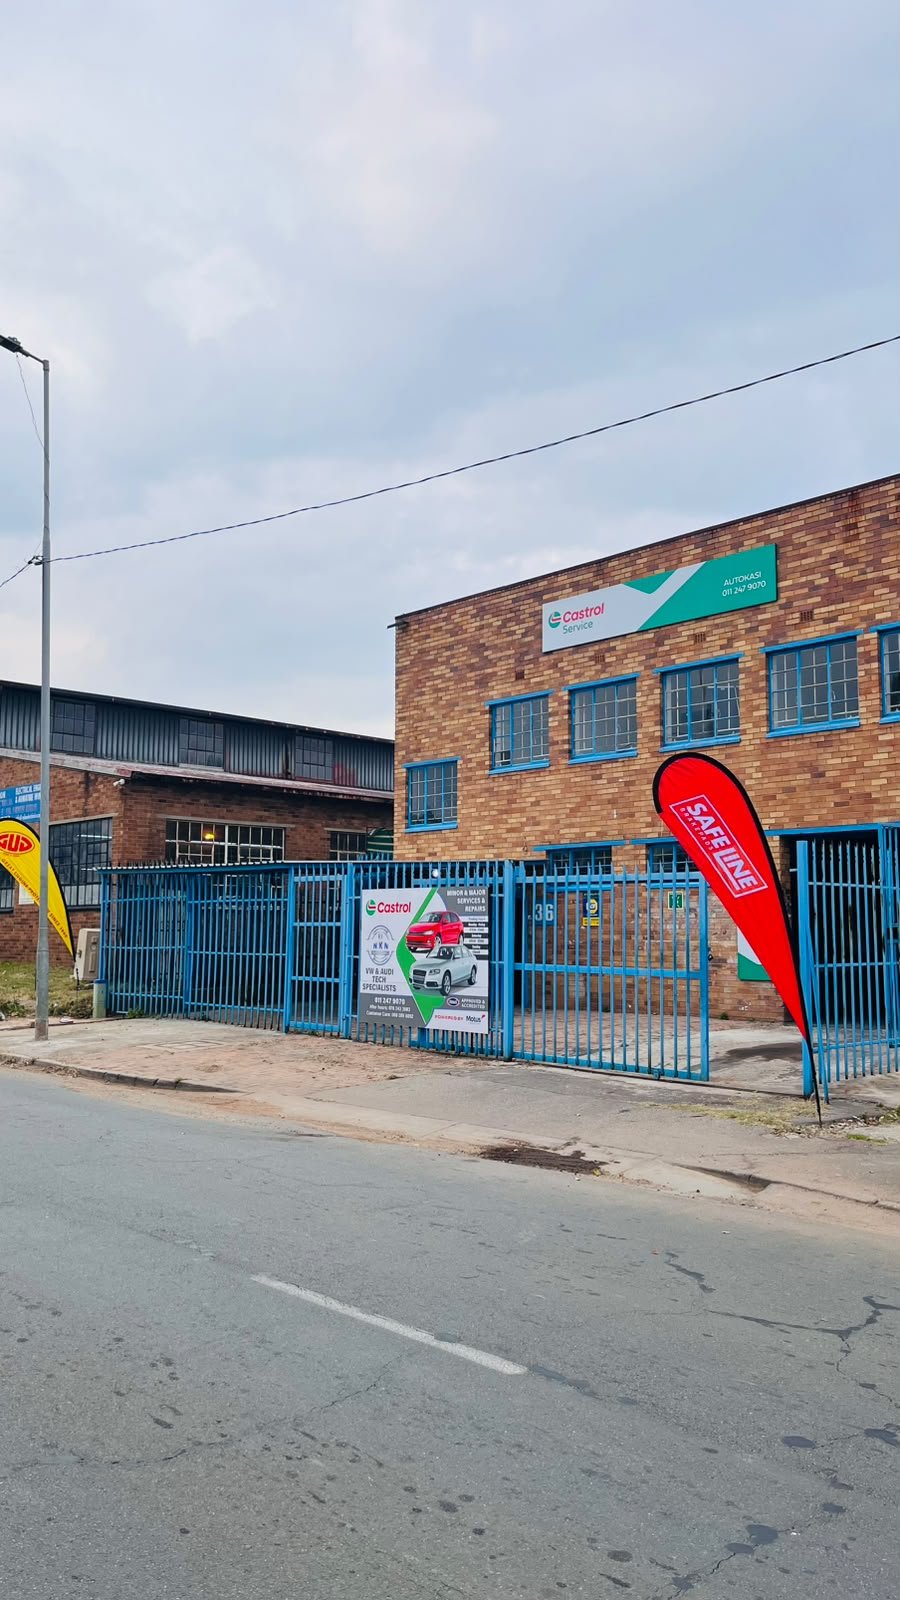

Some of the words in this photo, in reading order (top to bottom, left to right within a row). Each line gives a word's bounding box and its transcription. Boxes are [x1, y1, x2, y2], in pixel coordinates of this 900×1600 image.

[723, 571, 762, 587] AUTOKASI
[722, 588, 733, 597] 011
[734, 585, 746, 595] 247
[747, 580, 767, 591] 9070
[562, 602, 605, 623] Castrol
[562, 620, 593, 634] Service
[0, 833, 33, 852] GUD
[377, 901, 411, 913] Castrol
[457, 897, 480, 905] SERVICES
[535, 904, 554, 921] 36
[365, 967, 374, 975] VW
[380, 968, 394, 976] AUDI
[372, 975, 387, 983] TECH
[362, 983, 397, 992] SPECIALISTS
[465, 1015, 482, 1023] Motus
